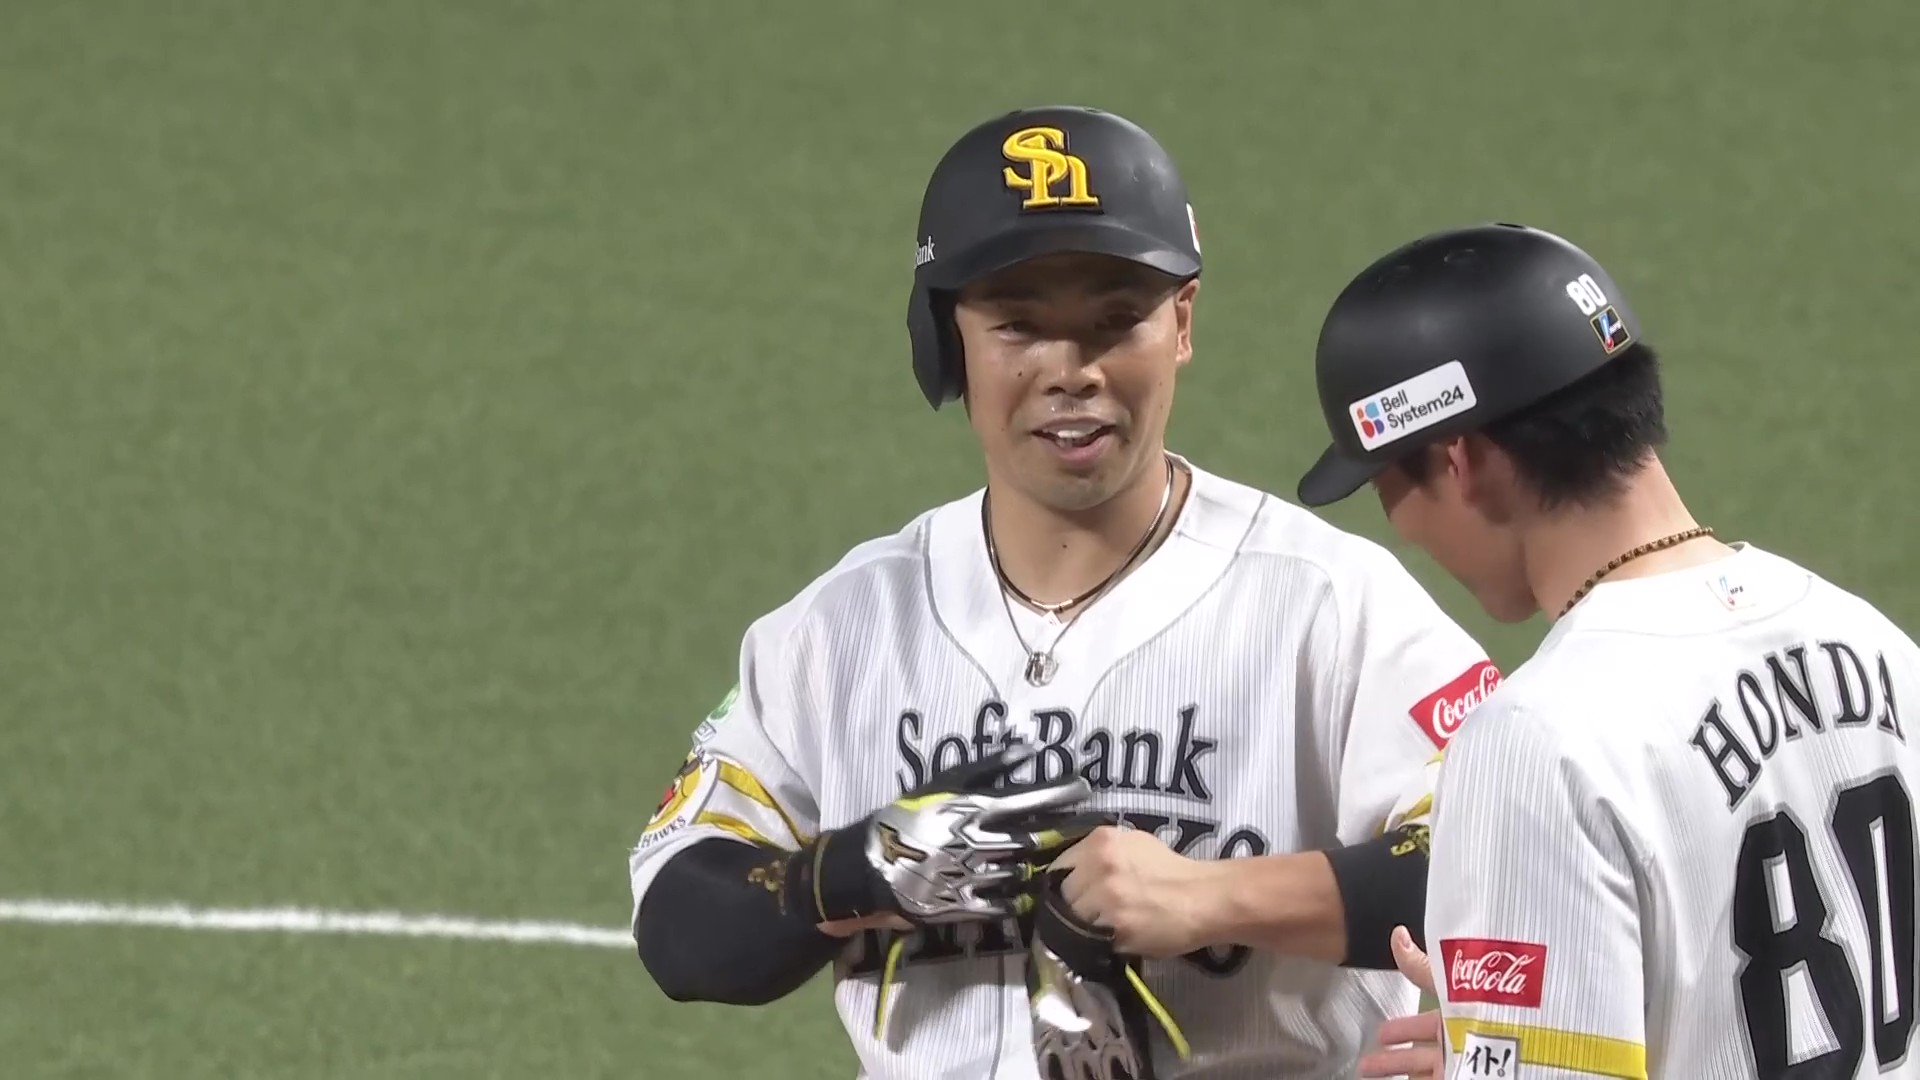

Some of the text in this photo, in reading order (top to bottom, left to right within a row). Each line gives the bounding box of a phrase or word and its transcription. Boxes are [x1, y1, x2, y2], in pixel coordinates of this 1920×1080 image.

[1566, 273, 1608, 317] 80
[1380, 389, 1409, 413] Bell
[1387, 384, 1465, 430] System24
[1432, 665, 1503, 739] Coca-Co
[1688, 638, 1907, 813] HONDA
[641, 816, 686, 849] HAWKS
[1730, 764, 1919, 1080] 80
[1451, 949, 1537, 995] Coca-Cola
